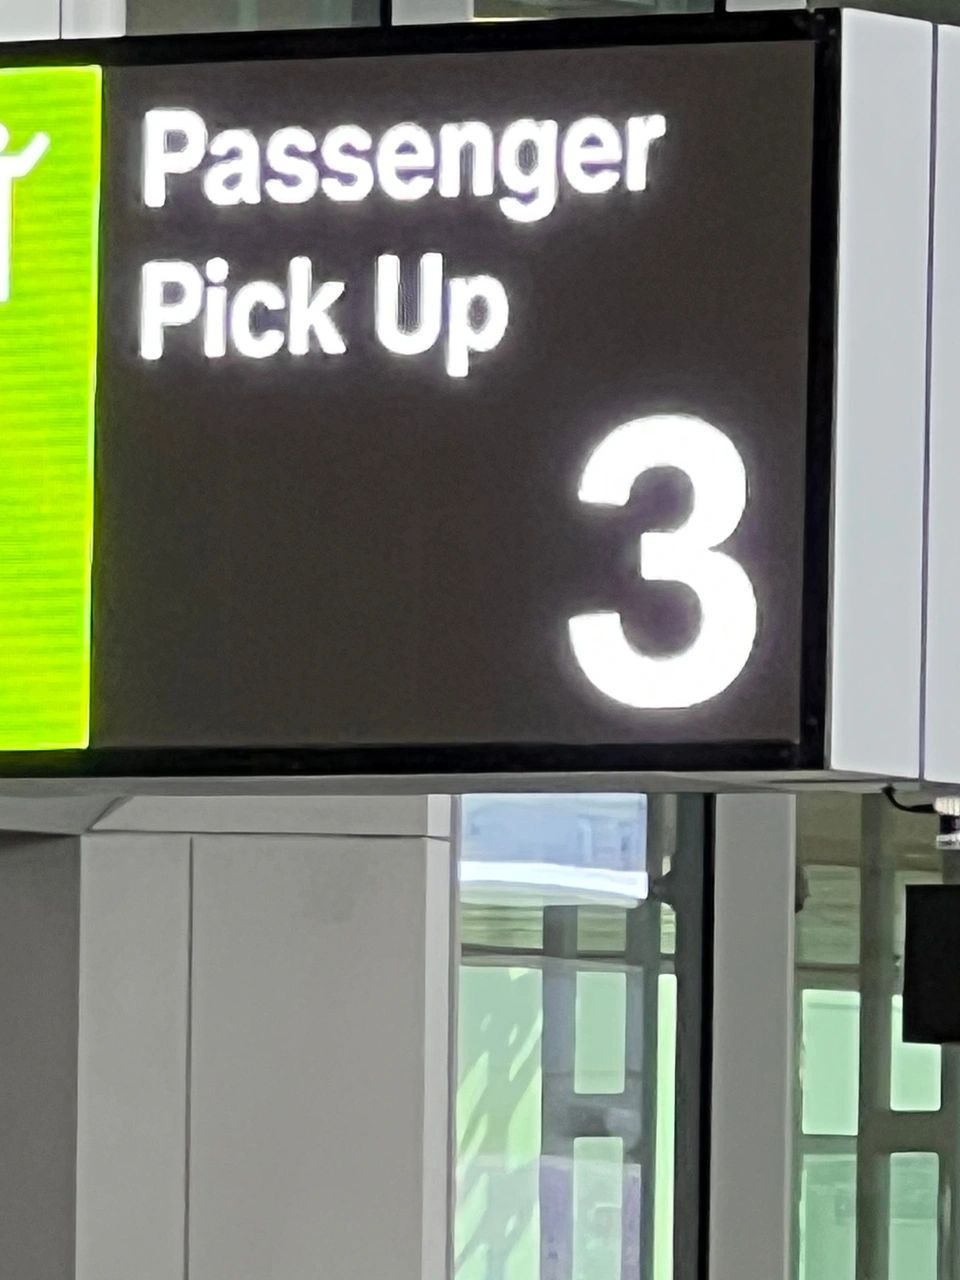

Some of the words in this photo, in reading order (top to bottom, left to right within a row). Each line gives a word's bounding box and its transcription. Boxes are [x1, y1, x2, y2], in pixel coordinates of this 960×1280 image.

[143, 108, 668, 224] Passenger
[140, 257, 347, 361] Pick
[374, 253, 510, 378] Up
[568, 414, 759, 709] 3
